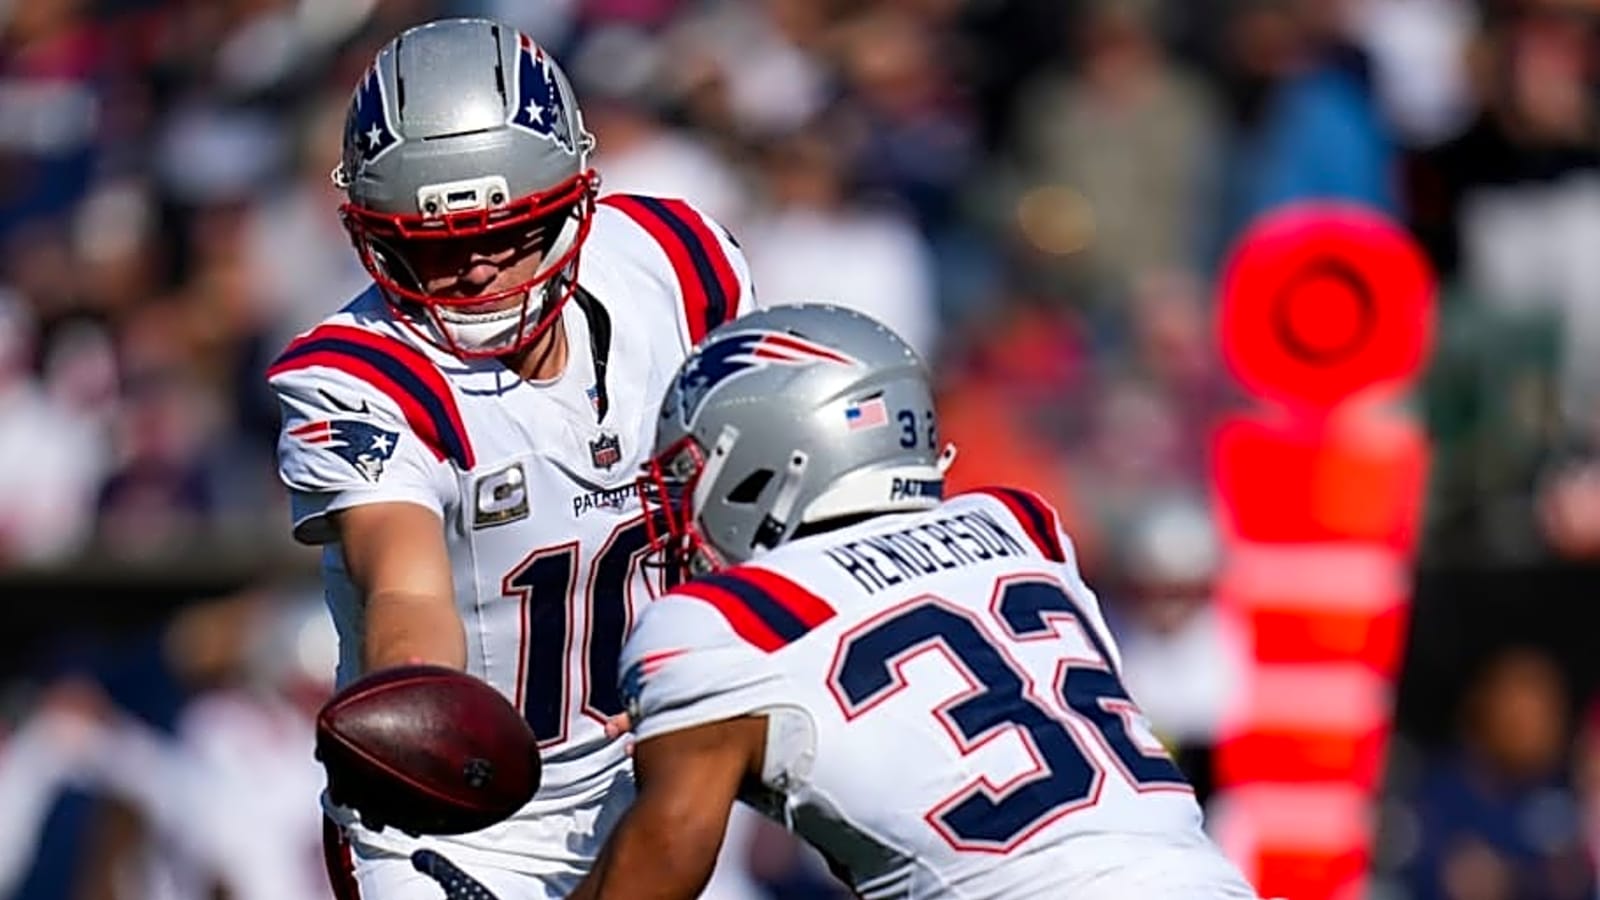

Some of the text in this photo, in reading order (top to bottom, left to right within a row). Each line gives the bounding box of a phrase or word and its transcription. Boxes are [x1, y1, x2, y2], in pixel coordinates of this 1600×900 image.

[479, 467, 524, 513] C
[825, 509, 1027, 594] HENDERSON
[826, 572, 1194, 854] 32
